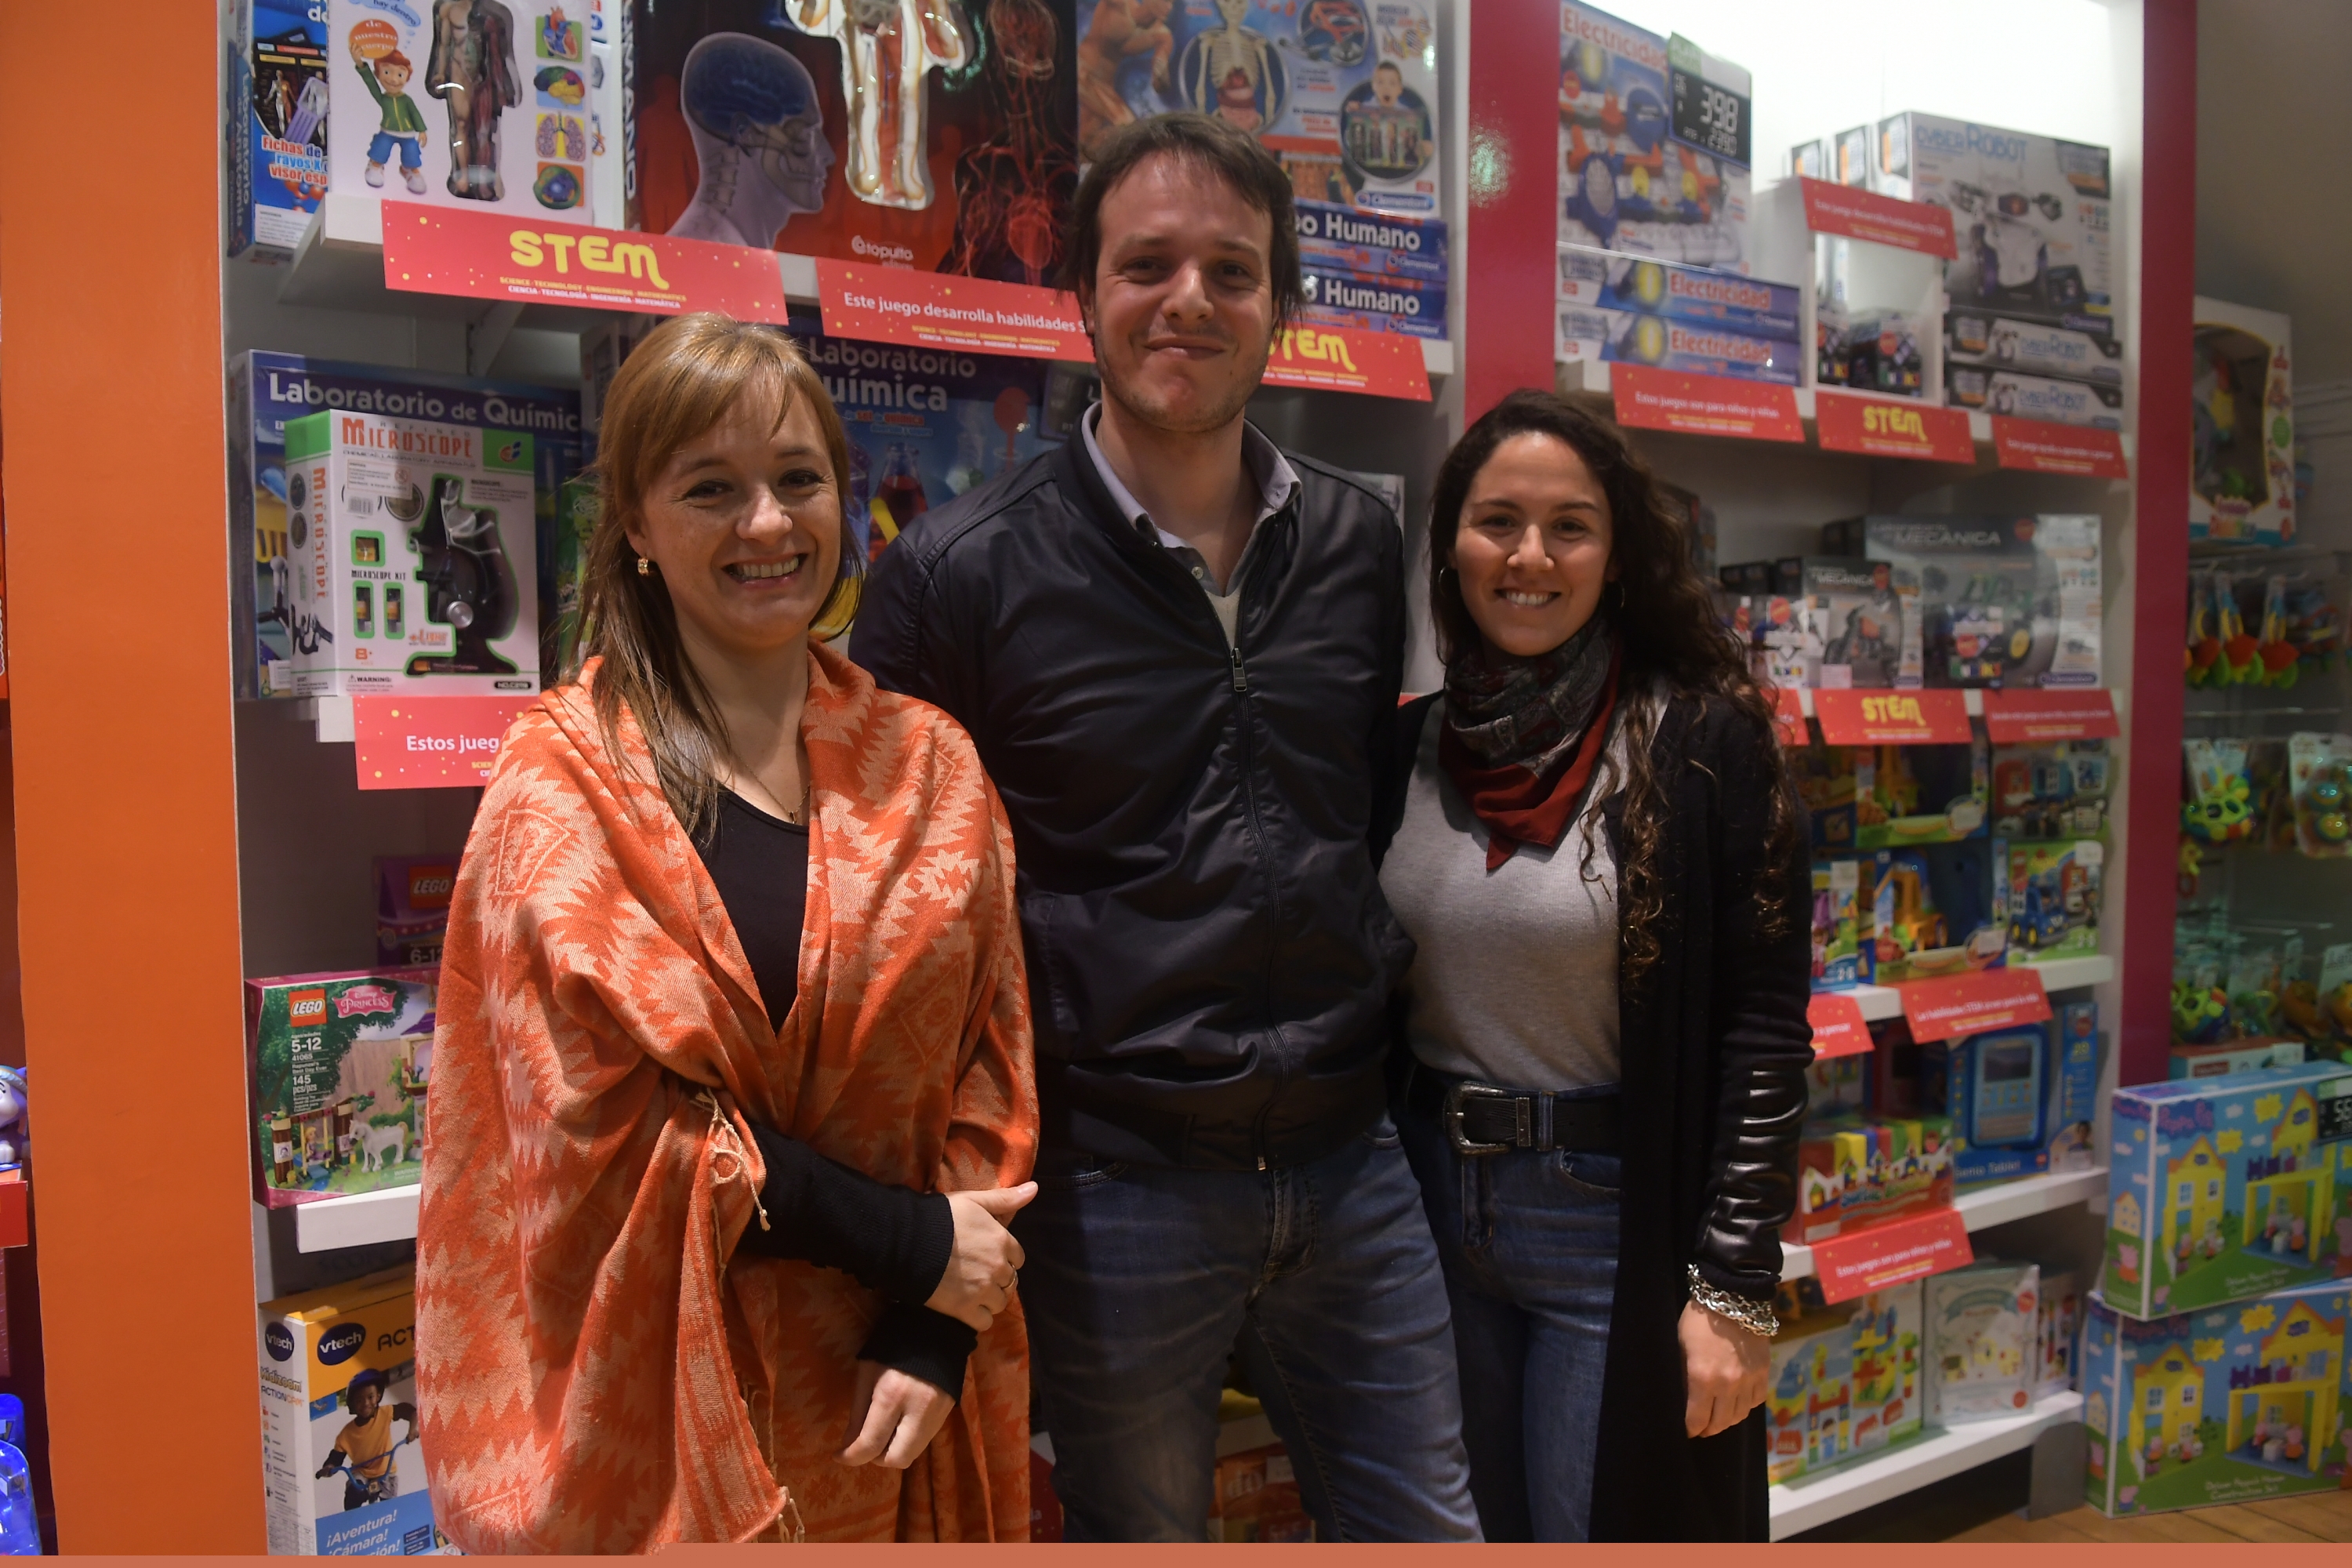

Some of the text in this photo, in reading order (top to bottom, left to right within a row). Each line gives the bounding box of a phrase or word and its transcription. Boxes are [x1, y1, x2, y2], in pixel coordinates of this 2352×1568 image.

[261, 135, 322, 158] Fichas de
[270, 164, 302, 182] visor
[275, 154, 311, 170] rayos
[1326, 212, 1421, 251] Humano
[509, 230, 670, 291] STEM
[1324, 279, 1420, 315] Humano
[844, 291, 876, 310] Este
[878, 296, 921, 318] juego
[924, 303, 994, 324] desarrolla
[996, 310, 1076, 332] habilidades
[808, 336, 977, 379] Laboratorio
[269, 372, 582, 433] Laboratorio de Químic
[1863, 405, 1928, 443] STEM
[342, 416, 474, 459] MICROSCOPE
[394, 572, 407, 582] KIT
[1861, 694, 1928, 728] STEM
[406, 734, 499, 754] Estos jueg
[413, 879, 450, 895] LEGO
[292, 1000, 323, 1017] LEGO
[292, 1036, 322, 1053] 5-12
[292, 1073, 311, 1086] 145
[292, 1083, 318, 1095] pcs/pzs
[267, 1334, 292, 1352] vtech
[319, 1330, 362, 1355] vtech
[326, 1508, 398, 1548] ¡Aventura!
